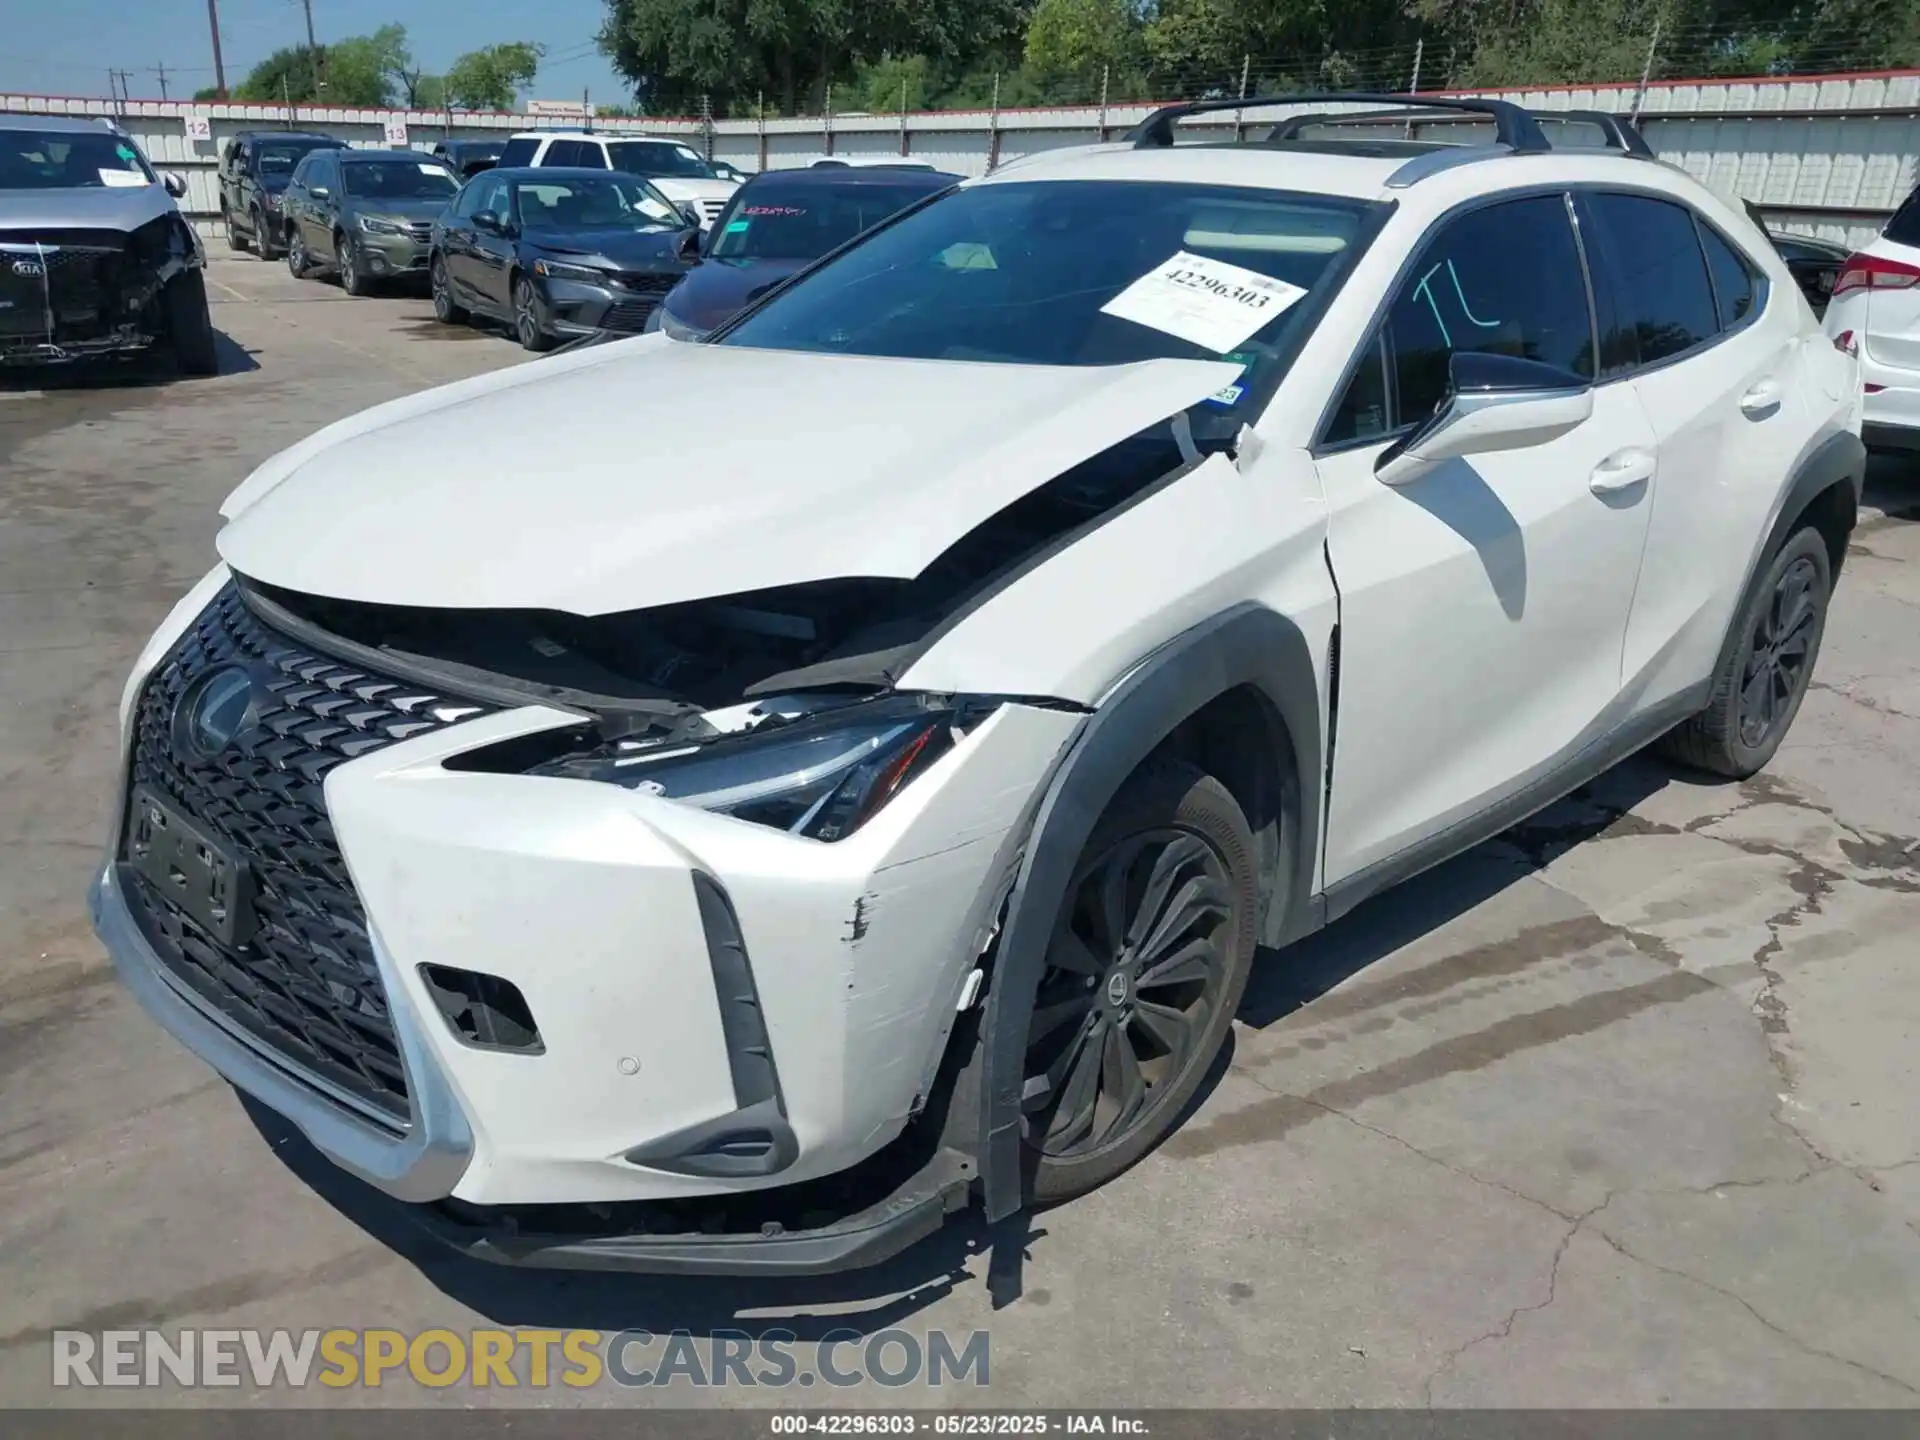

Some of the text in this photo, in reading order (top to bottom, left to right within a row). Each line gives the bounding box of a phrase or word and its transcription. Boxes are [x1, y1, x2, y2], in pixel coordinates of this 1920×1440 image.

[188, 122, 208, 135] 12
[388, 128, 405, 140] 13
[19, 263, 42, 275] KIA
[1165, 269, 1271, 309] 42296303
